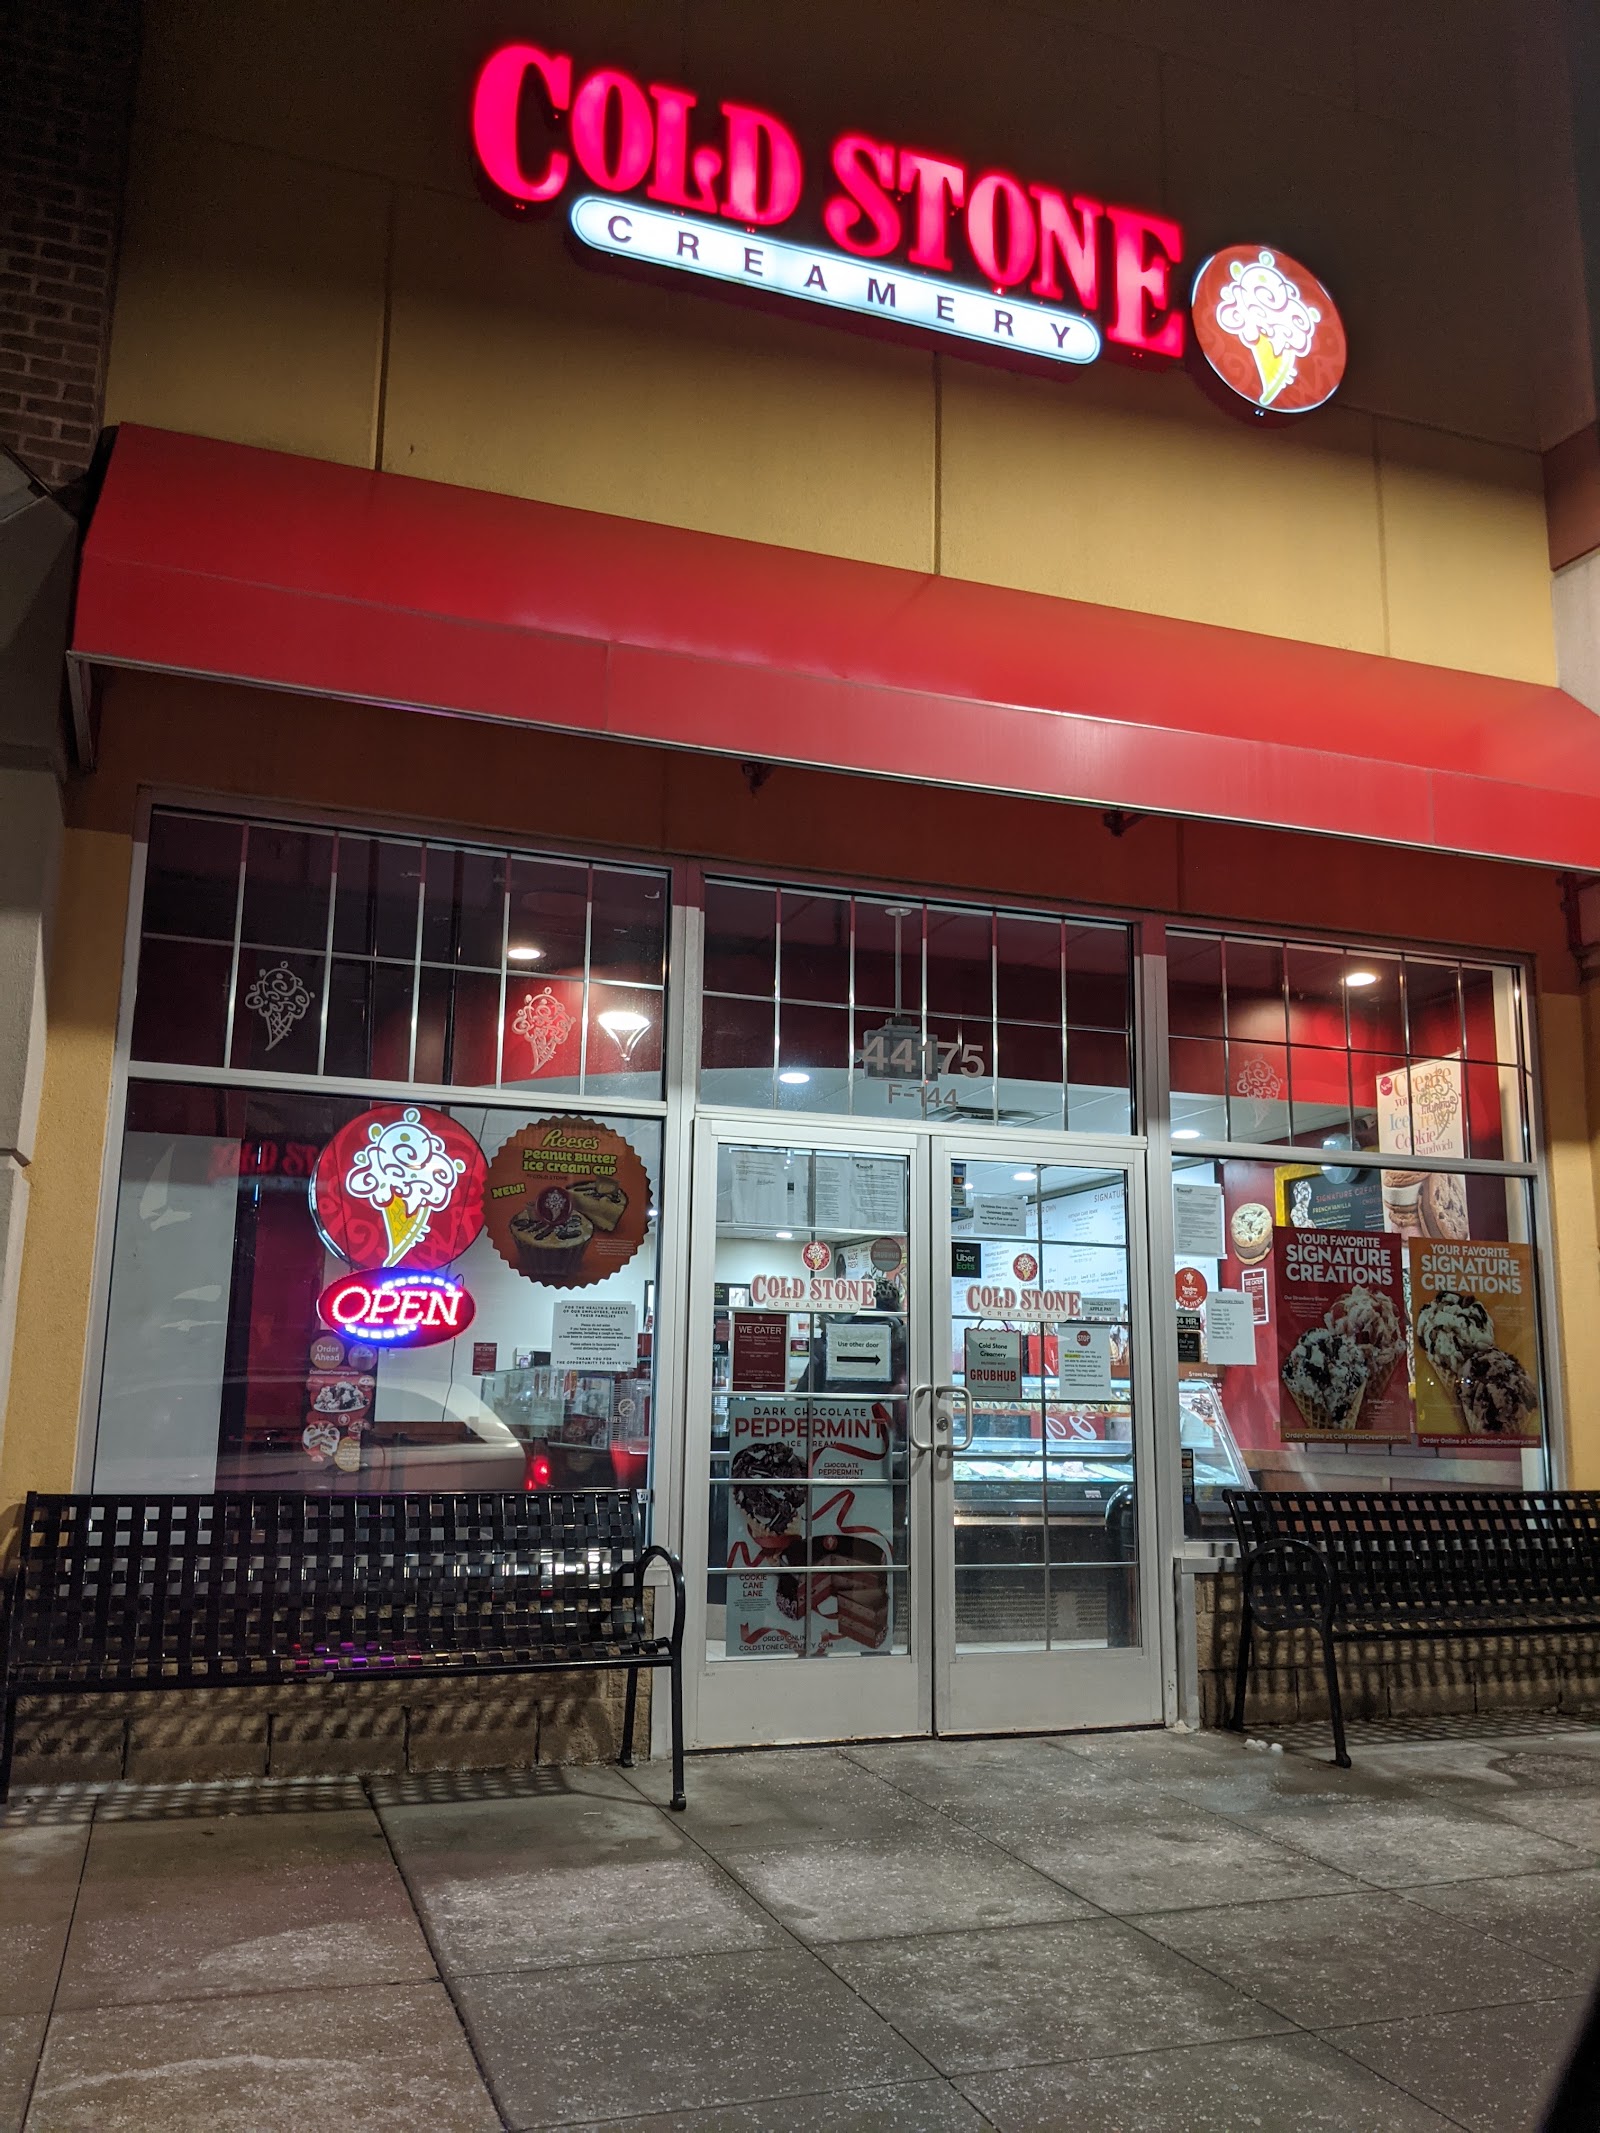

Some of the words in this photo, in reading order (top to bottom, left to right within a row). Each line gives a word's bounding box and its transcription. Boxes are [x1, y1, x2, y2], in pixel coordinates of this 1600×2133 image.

[472, 45, 802, 226] COLD
[825, 133, 1183, 356] STONE
[607, 215, 1072, 349] CREAMERY
[862, 1036, 985, 1078] 44175
[888, 1084, 959, 1111] F-144
[542, 1129, 600, 1149] Reese's
[1416, 1139, 1453, 1155] Sandwich
[524, 1150, 572, 1161] Peanut
[574, 1152, 617, 1164] Butter
[523, 1160, 544, 1171] Ice
[492, 1184, 526, 1199] NEW!
[1094, 1190, 1124, 1202] SIGNATUR
[1316, 1190, 1352, 1202] SIGNATURE
[1354, 1185, 1382, 1196] CREAT
[1296, 1233, 1328, 1245] YOUR
[1330, 1236, 1380, 1248] FAVORITE
[956, 1254, 975, 1262] Uber
[1285, 1244, 1391, 1266] SIGNATURE
[1430, 1244, 1460, 1255] YOUR
[1462, 1246, 1510, 1258] FAVORITE
[1421, 1255, 1520, 1276] SIGNATURE
[1285, 1264, 1393, 1285] CREATIONS
[752, 1275, 805, 1304] COLD
[810, 1279, 875, 1306] STONE
[1421, 1274, 1522, 1294] CREATIONS
[332, 1286, 463, 1325] OPEN
[967, 1285, 1016, 1312] COLD
[1021, 1289, 1081, 1316] STONE
[987, 1310, 1061, 1318] CREAMERY
[754, 1326, 782, 1334] CATER
[317, 1344, 339, 1352] Order
[970, 1369, 1016, 1382] GRUBHUB
[754, 1407, 786, 1416] DARK
[794, 1407, 866, 1417] CHOCOLATE
[735, 1417, 887, 1439] PEPPERMINT
[1334, 1433, 1407, 1441] ColdStoneCreamery.com
[1468, 1438, 1538, 1446] ColdStoneCreamery.com
